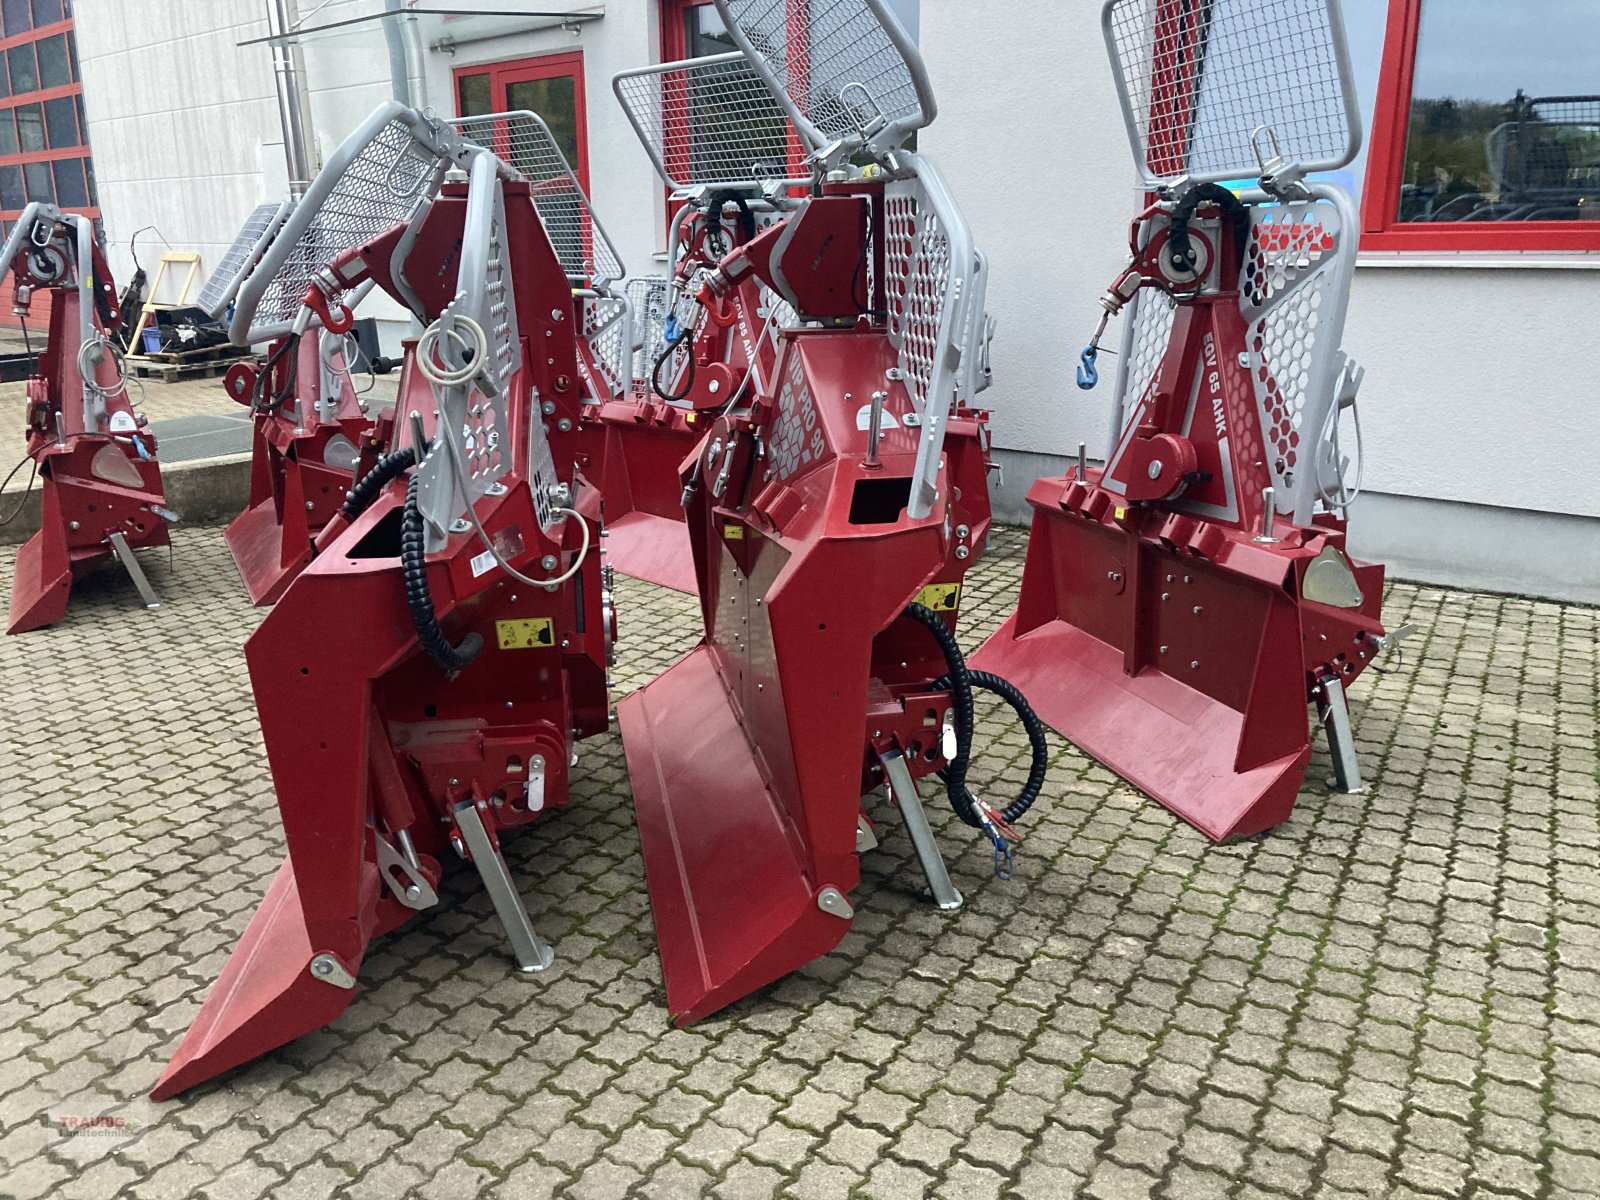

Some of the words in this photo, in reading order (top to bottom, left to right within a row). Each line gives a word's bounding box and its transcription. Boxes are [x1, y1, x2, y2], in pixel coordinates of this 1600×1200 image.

[1203, 331, 1217, 367] EGV
[1209, 371, 1220, 394] 65
[789, 350, 804, 386] VIP
[798, 384, 816, 431] PRO
[811, 428, 825, 460] 90
[1212, 398, 1227, 436] AHK
